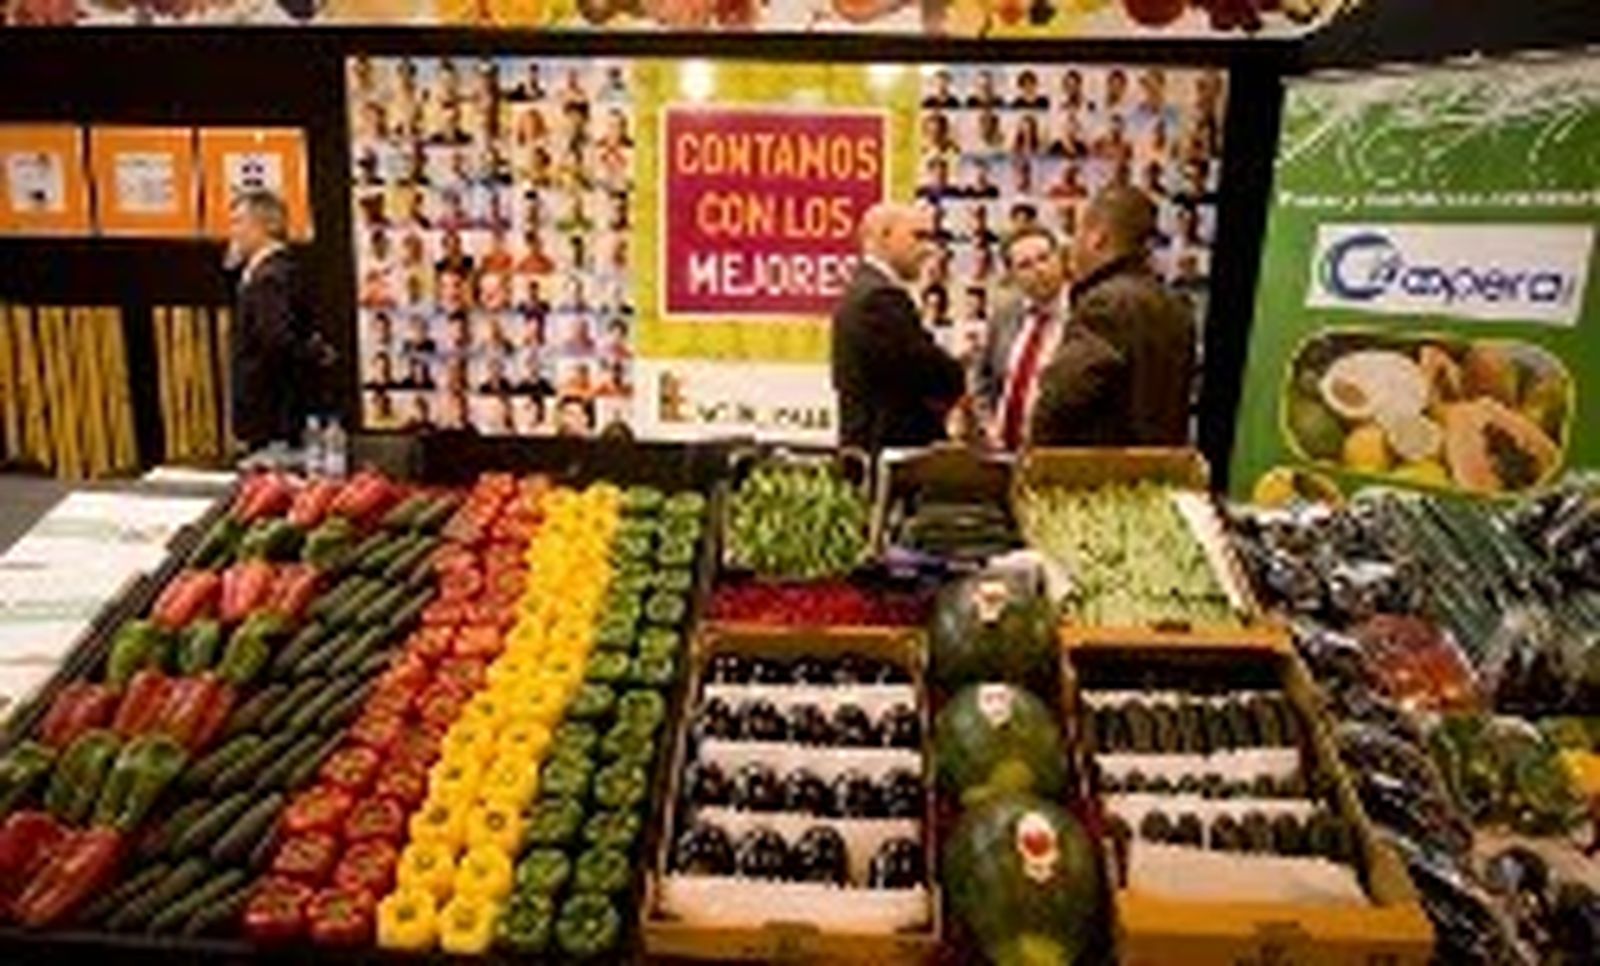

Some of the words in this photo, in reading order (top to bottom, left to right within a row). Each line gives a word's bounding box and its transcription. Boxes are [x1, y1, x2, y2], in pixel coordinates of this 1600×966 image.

[676, 132, 879, 181] CONTAMOS
[696, 190, 776, 237] CON
[784, 195, 853, 240] LOS
